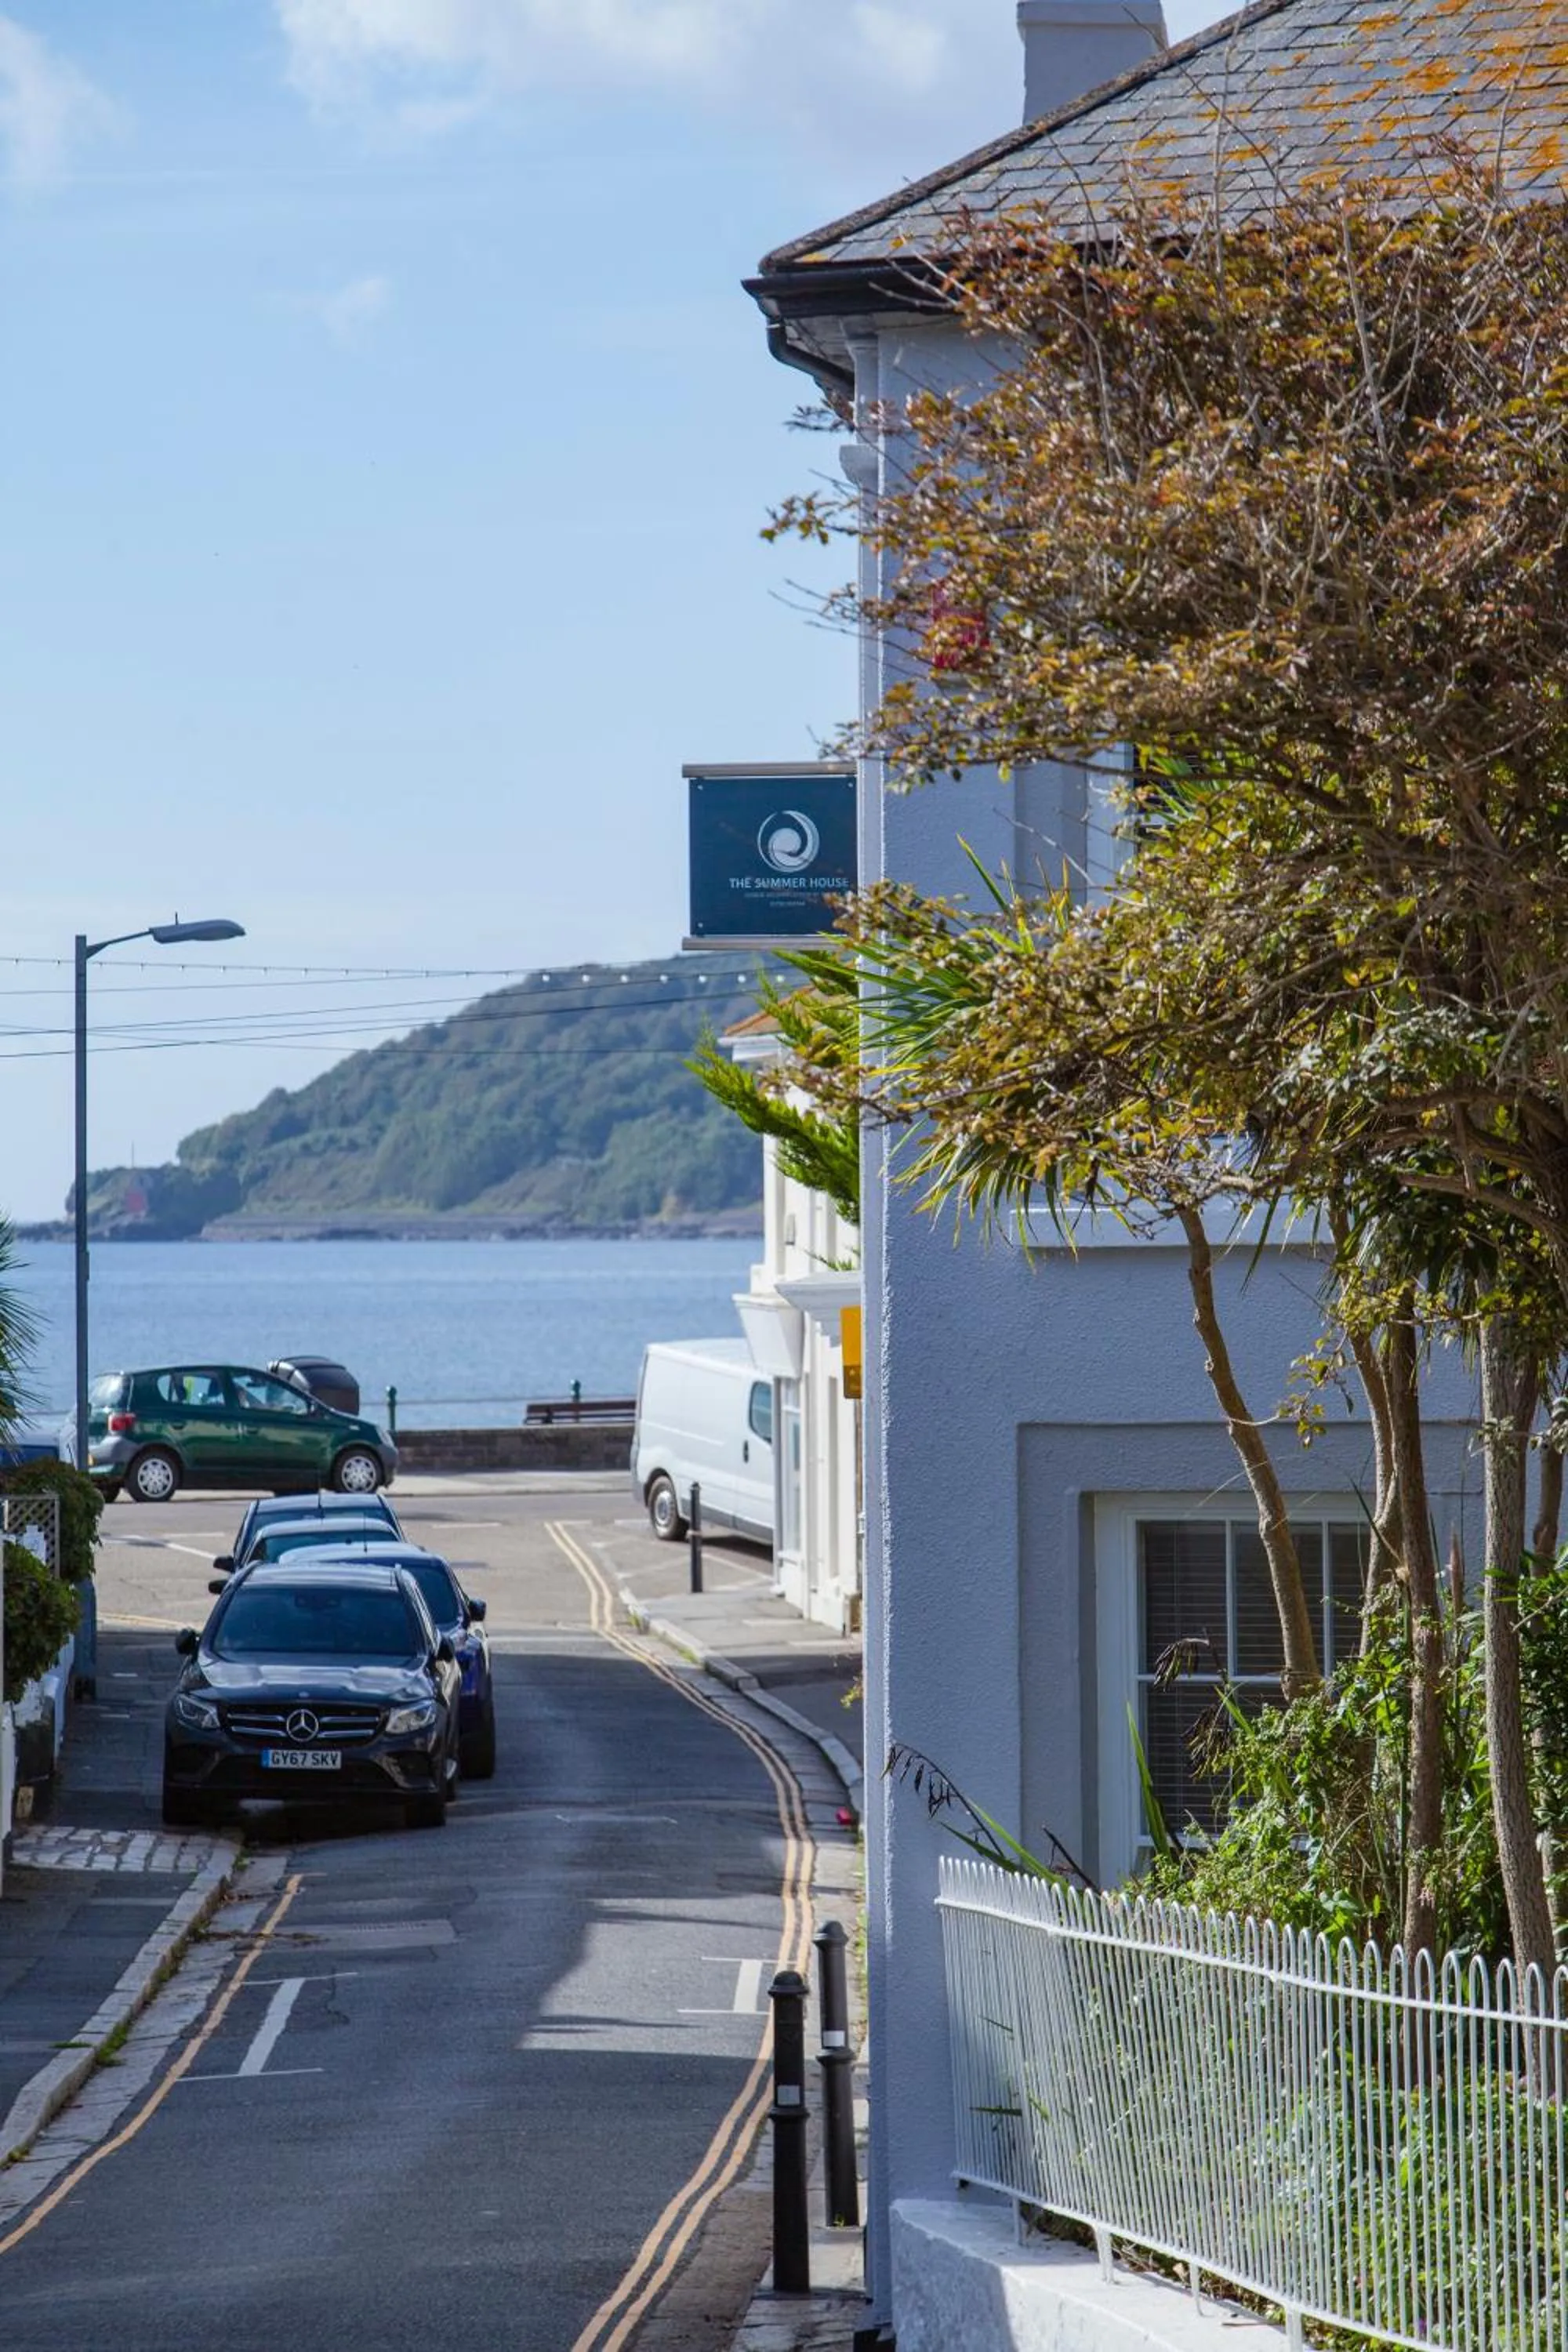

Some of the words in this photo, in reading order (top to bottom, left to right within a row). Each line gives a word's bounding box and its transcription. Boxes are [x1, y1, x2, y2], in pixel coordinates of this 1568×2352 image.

[728, 877, 751, 888] THE
[754, 877, 806, 888] SUMMER
[809, 877, 850, 888] HOUSE
[271, 1751, 307, 1766] GY67
